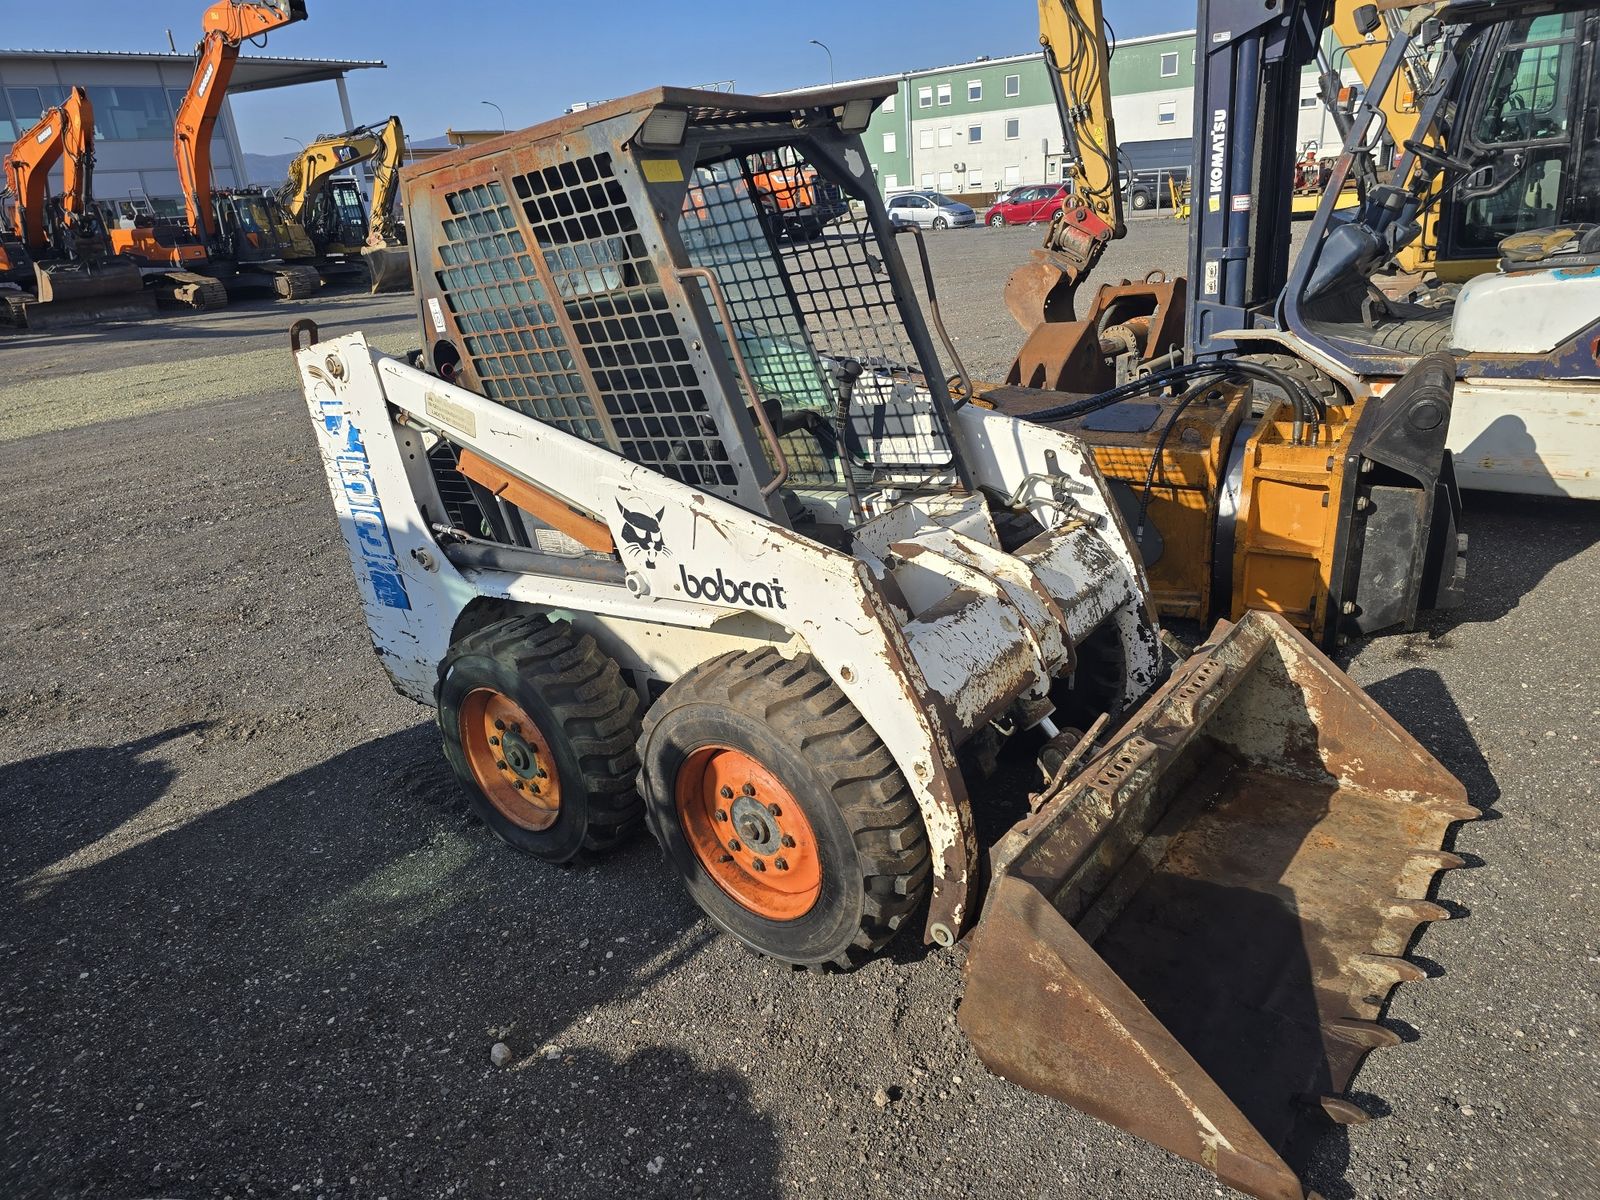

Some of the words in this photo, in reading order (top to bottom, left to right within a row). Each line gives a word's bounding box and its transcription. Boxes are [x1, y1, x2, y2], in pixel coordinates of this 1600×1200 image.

[339, 146, 352, 162] CAT
[1210, 109, 1227, 193] KOMATSU
[678, 564, 787, 610] bobcat
